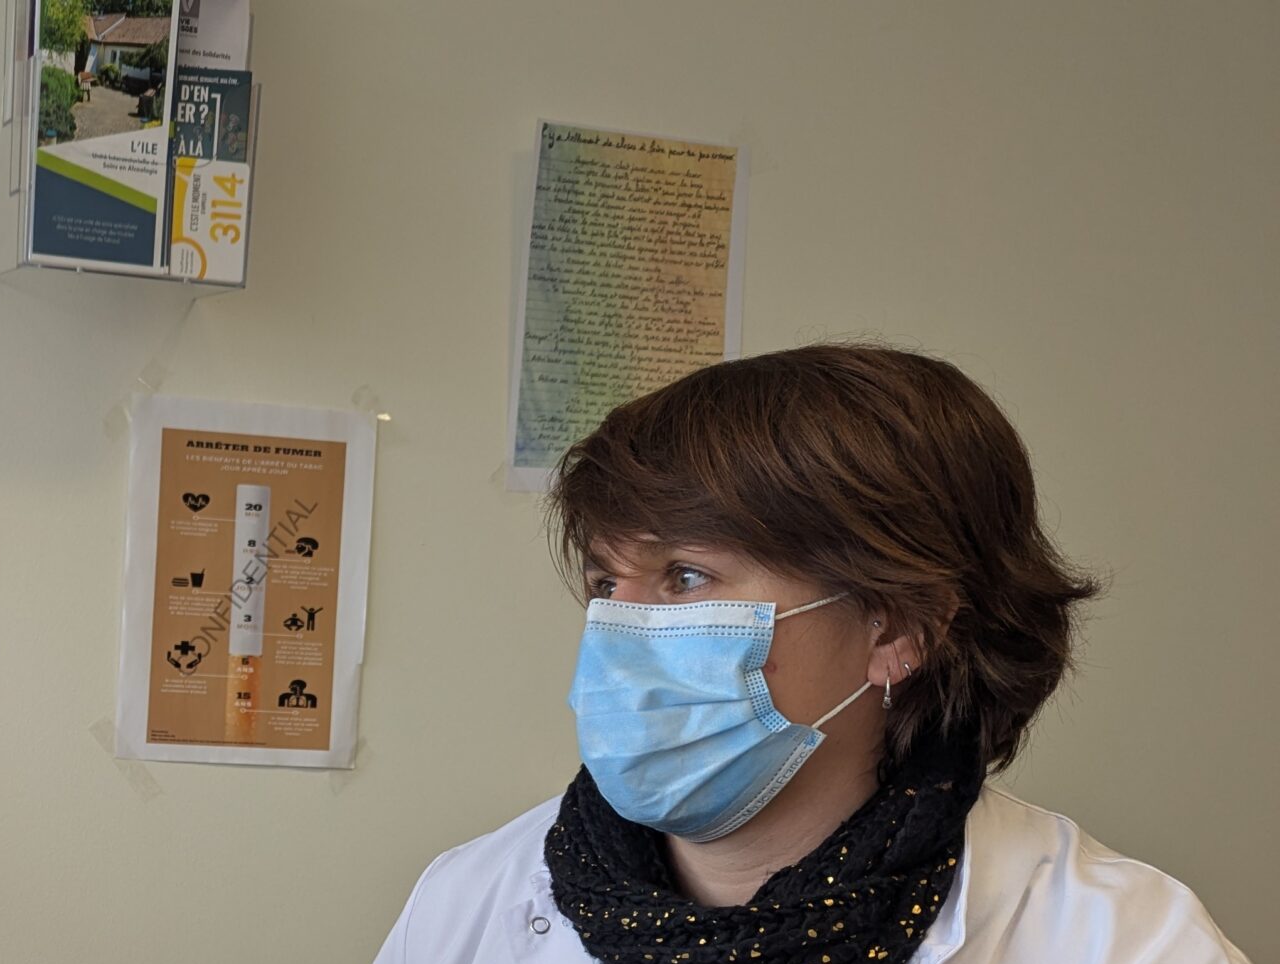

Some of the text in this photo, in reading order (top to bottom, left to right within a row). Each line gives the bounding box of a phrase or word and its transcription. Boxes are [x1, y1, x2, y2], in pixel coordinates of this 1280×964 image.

[131, 141, 158, 155] L'ILE
[210, 172, 245, 245] 3114
[186, 440, 323, 458] ARRÊTER DE FUMER
[245, 503, 262, 511] 20
[248, 540, 256, 548] 8
[236, 692, 251, 700] 15
